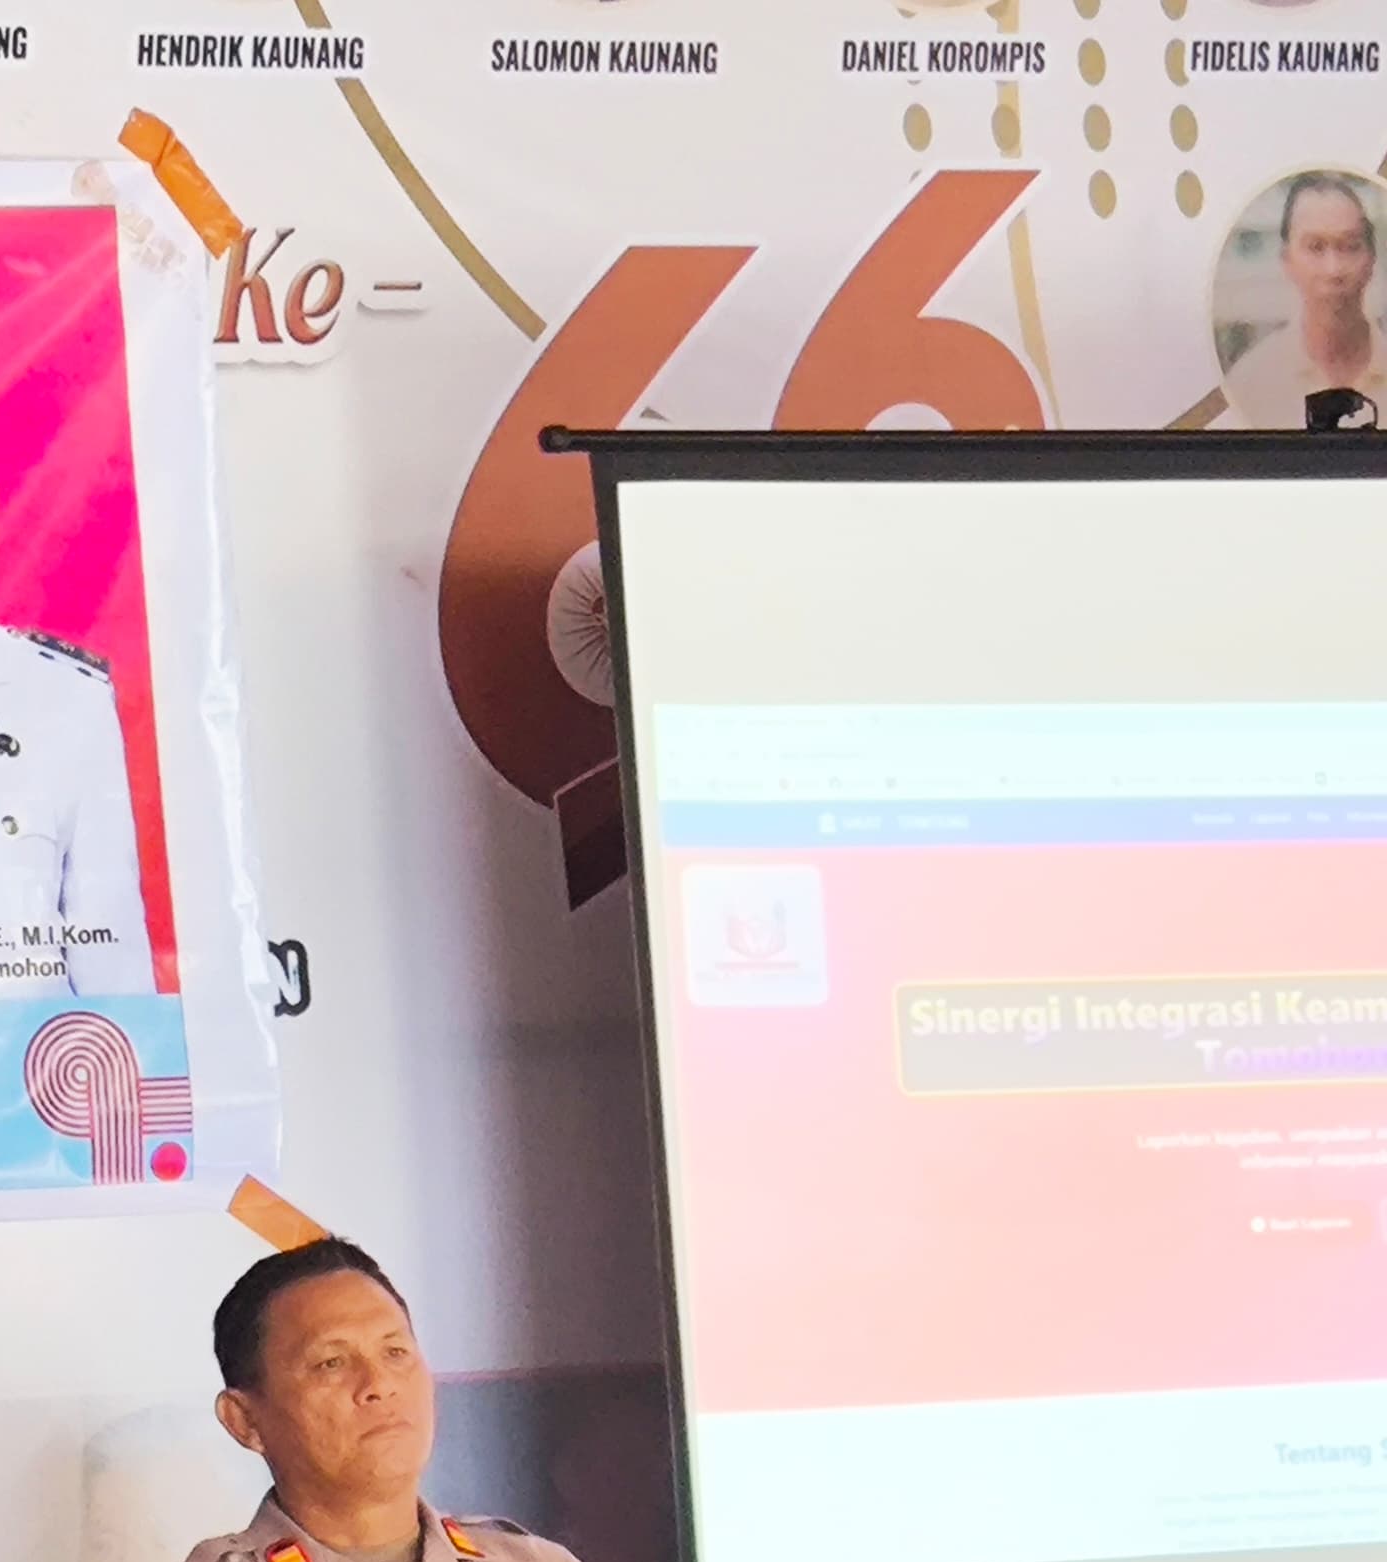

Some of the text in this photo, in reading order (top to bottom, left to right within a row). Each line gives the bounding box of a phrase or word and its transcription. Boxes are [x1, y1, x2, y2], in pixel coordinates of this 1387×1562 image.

[138, 34, 364, 70] HENDRIK KAUNANG
[491, 39, 718, 74] SALOMON KAUNANG
[842, 40, 1046, 74] DANIEL KOROMPIS
[1190, 40, 1380, 74] FIDELIS KAUNANG
[213, 226, 345, 346] Ke
[23, 924, 119, 948] M.I.Kom.
[910, 996, 1061, 1043] Sinergi
[1075, 990, 1262, 1039] Integrasi
[1274, 1442, 1373, 1469] Tentang
